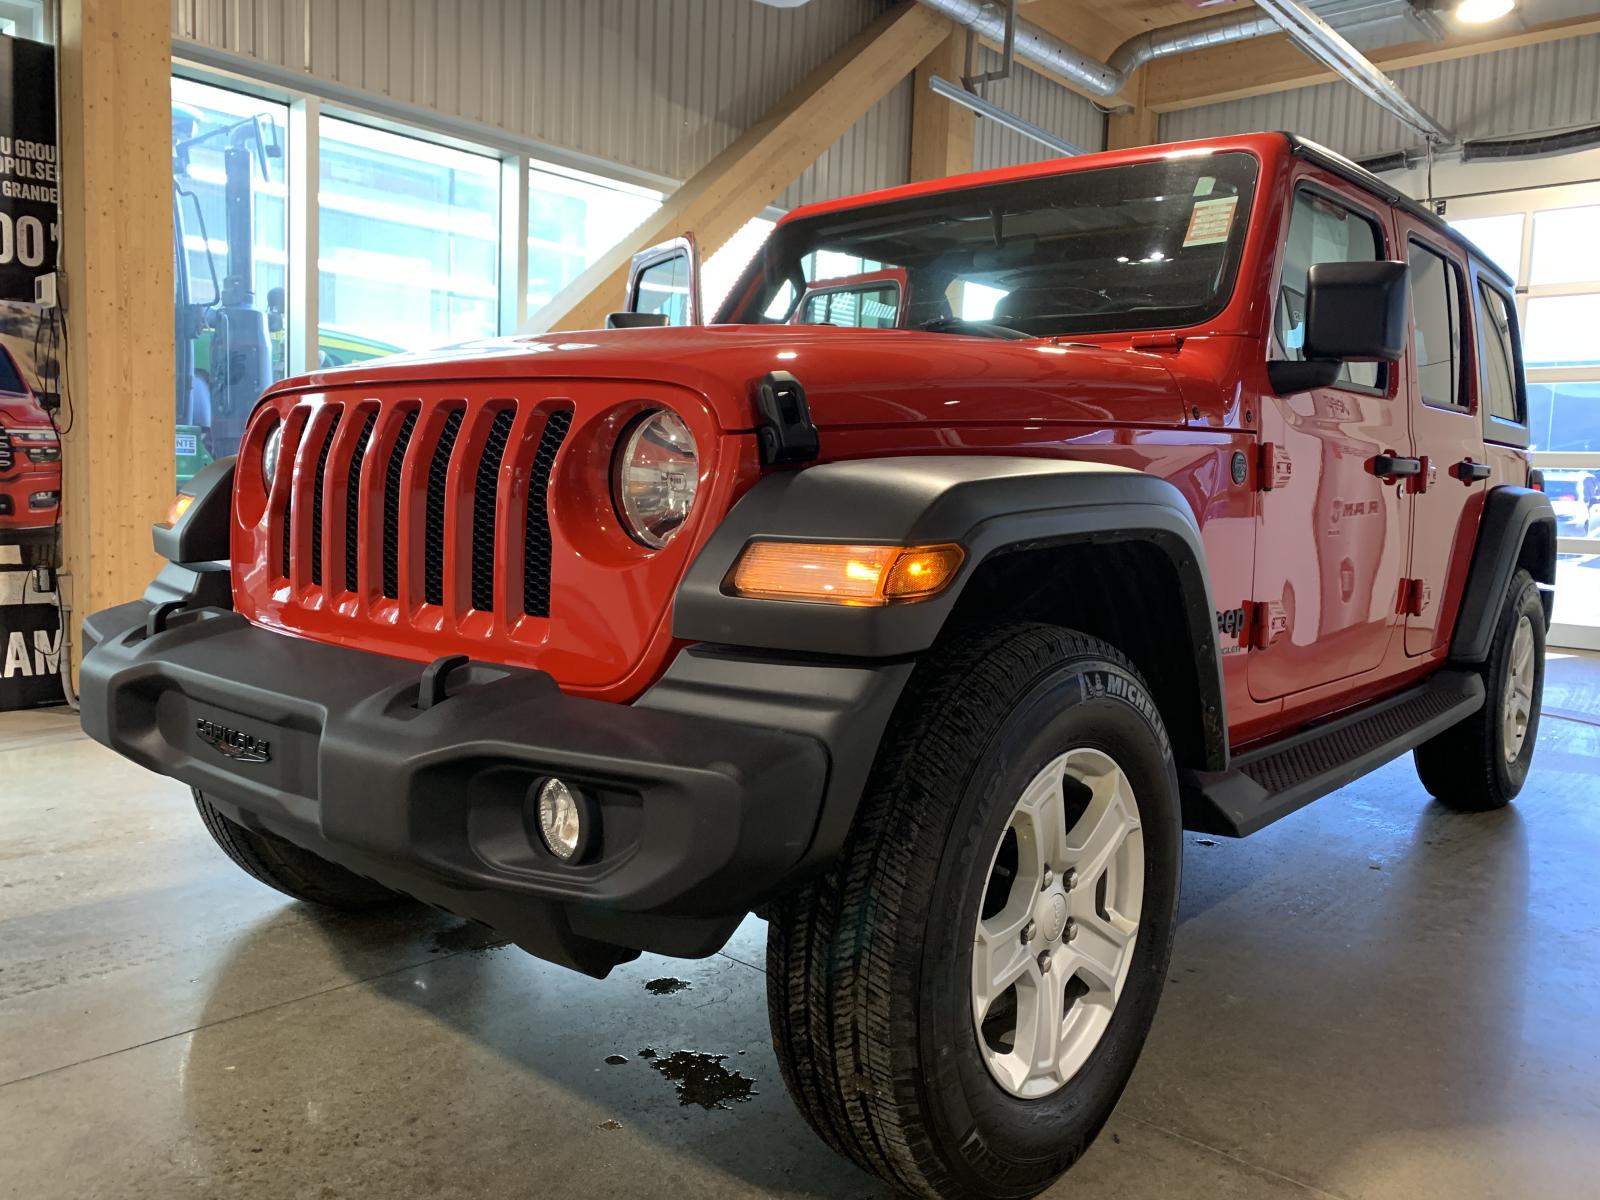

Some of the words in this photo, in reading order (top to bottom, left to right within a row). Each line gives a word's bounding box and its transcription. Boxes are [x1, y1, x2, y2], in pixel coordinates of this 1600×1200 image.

[0, 156, 57, 181] PULSE
[0, 630, 61, 678] AM
[1106, 673, 1172, 762] MICHELIN
